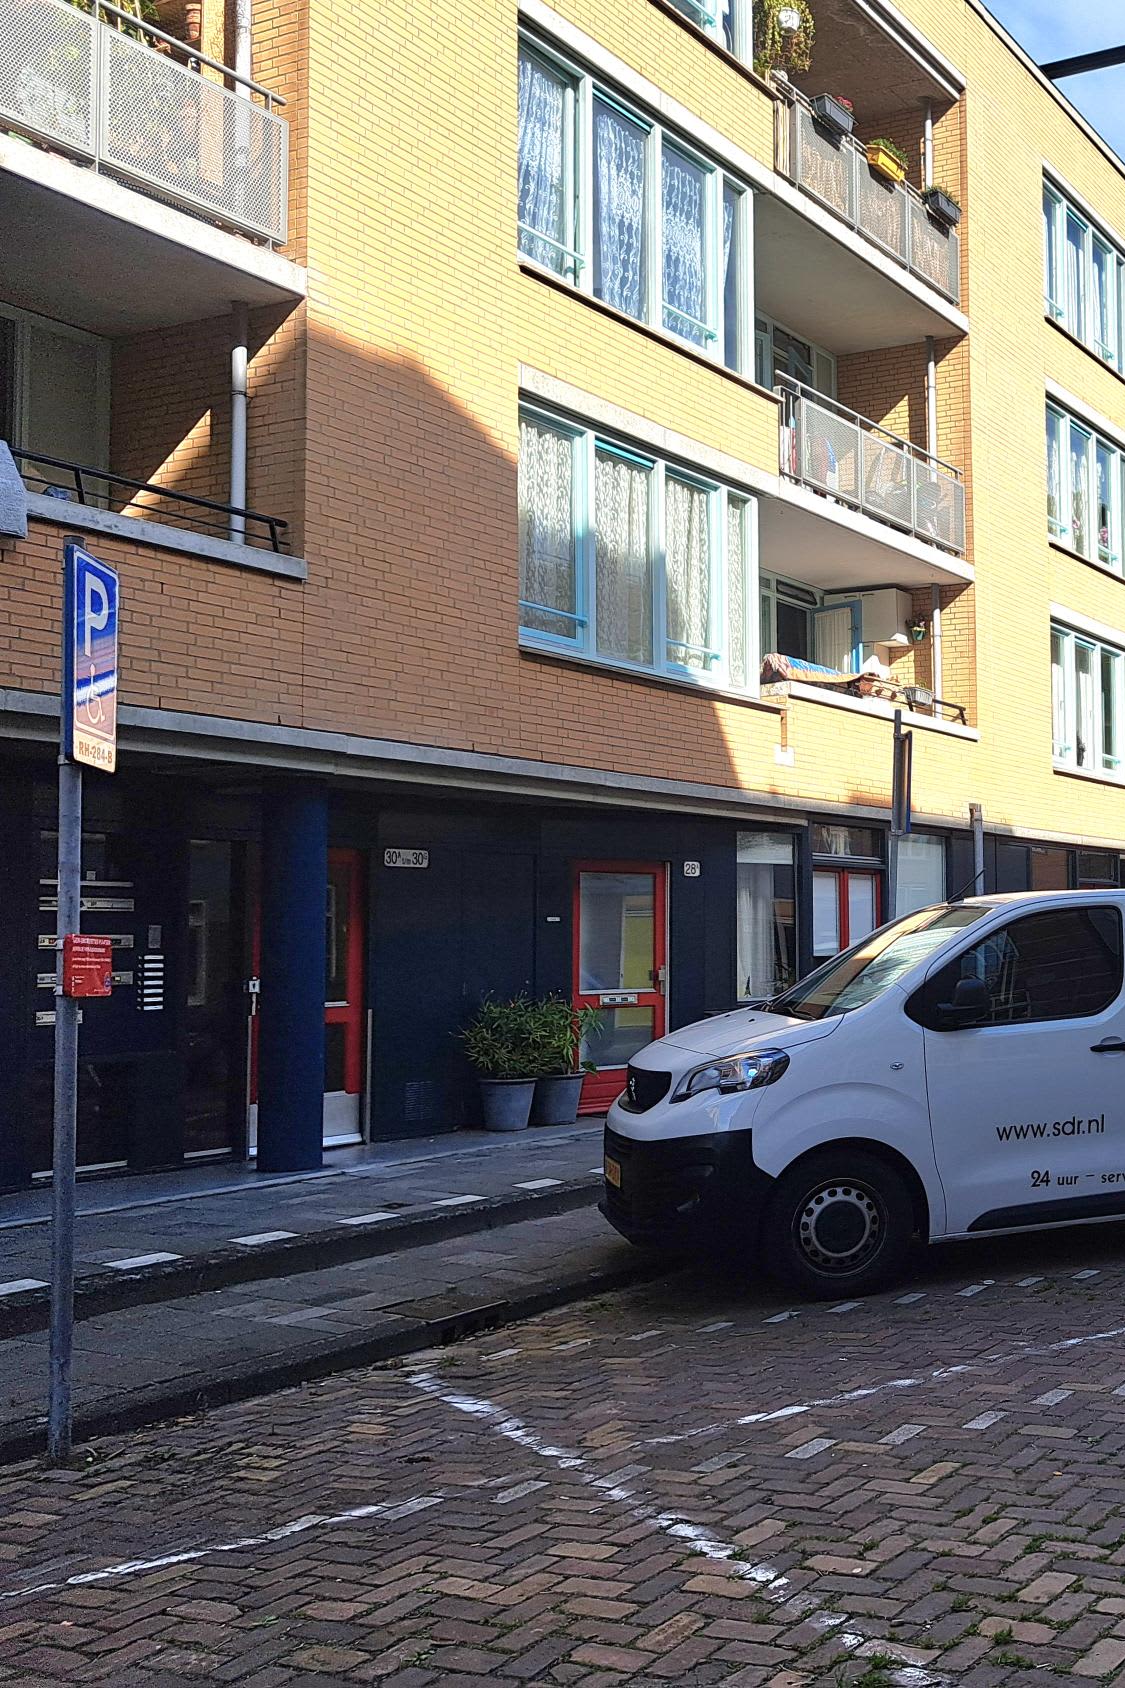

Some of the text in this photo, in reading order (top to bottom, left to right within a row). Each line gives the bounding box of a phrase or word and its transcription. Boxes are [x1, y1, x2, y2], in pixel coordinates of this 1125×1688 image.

[85, 571, 109, 657] P
[996, 1114, 1105, 1142] www.sdr.nl
[1031, 1170, 1050, 1188] 24
[1057, 1174, 1079, 1186] uur
